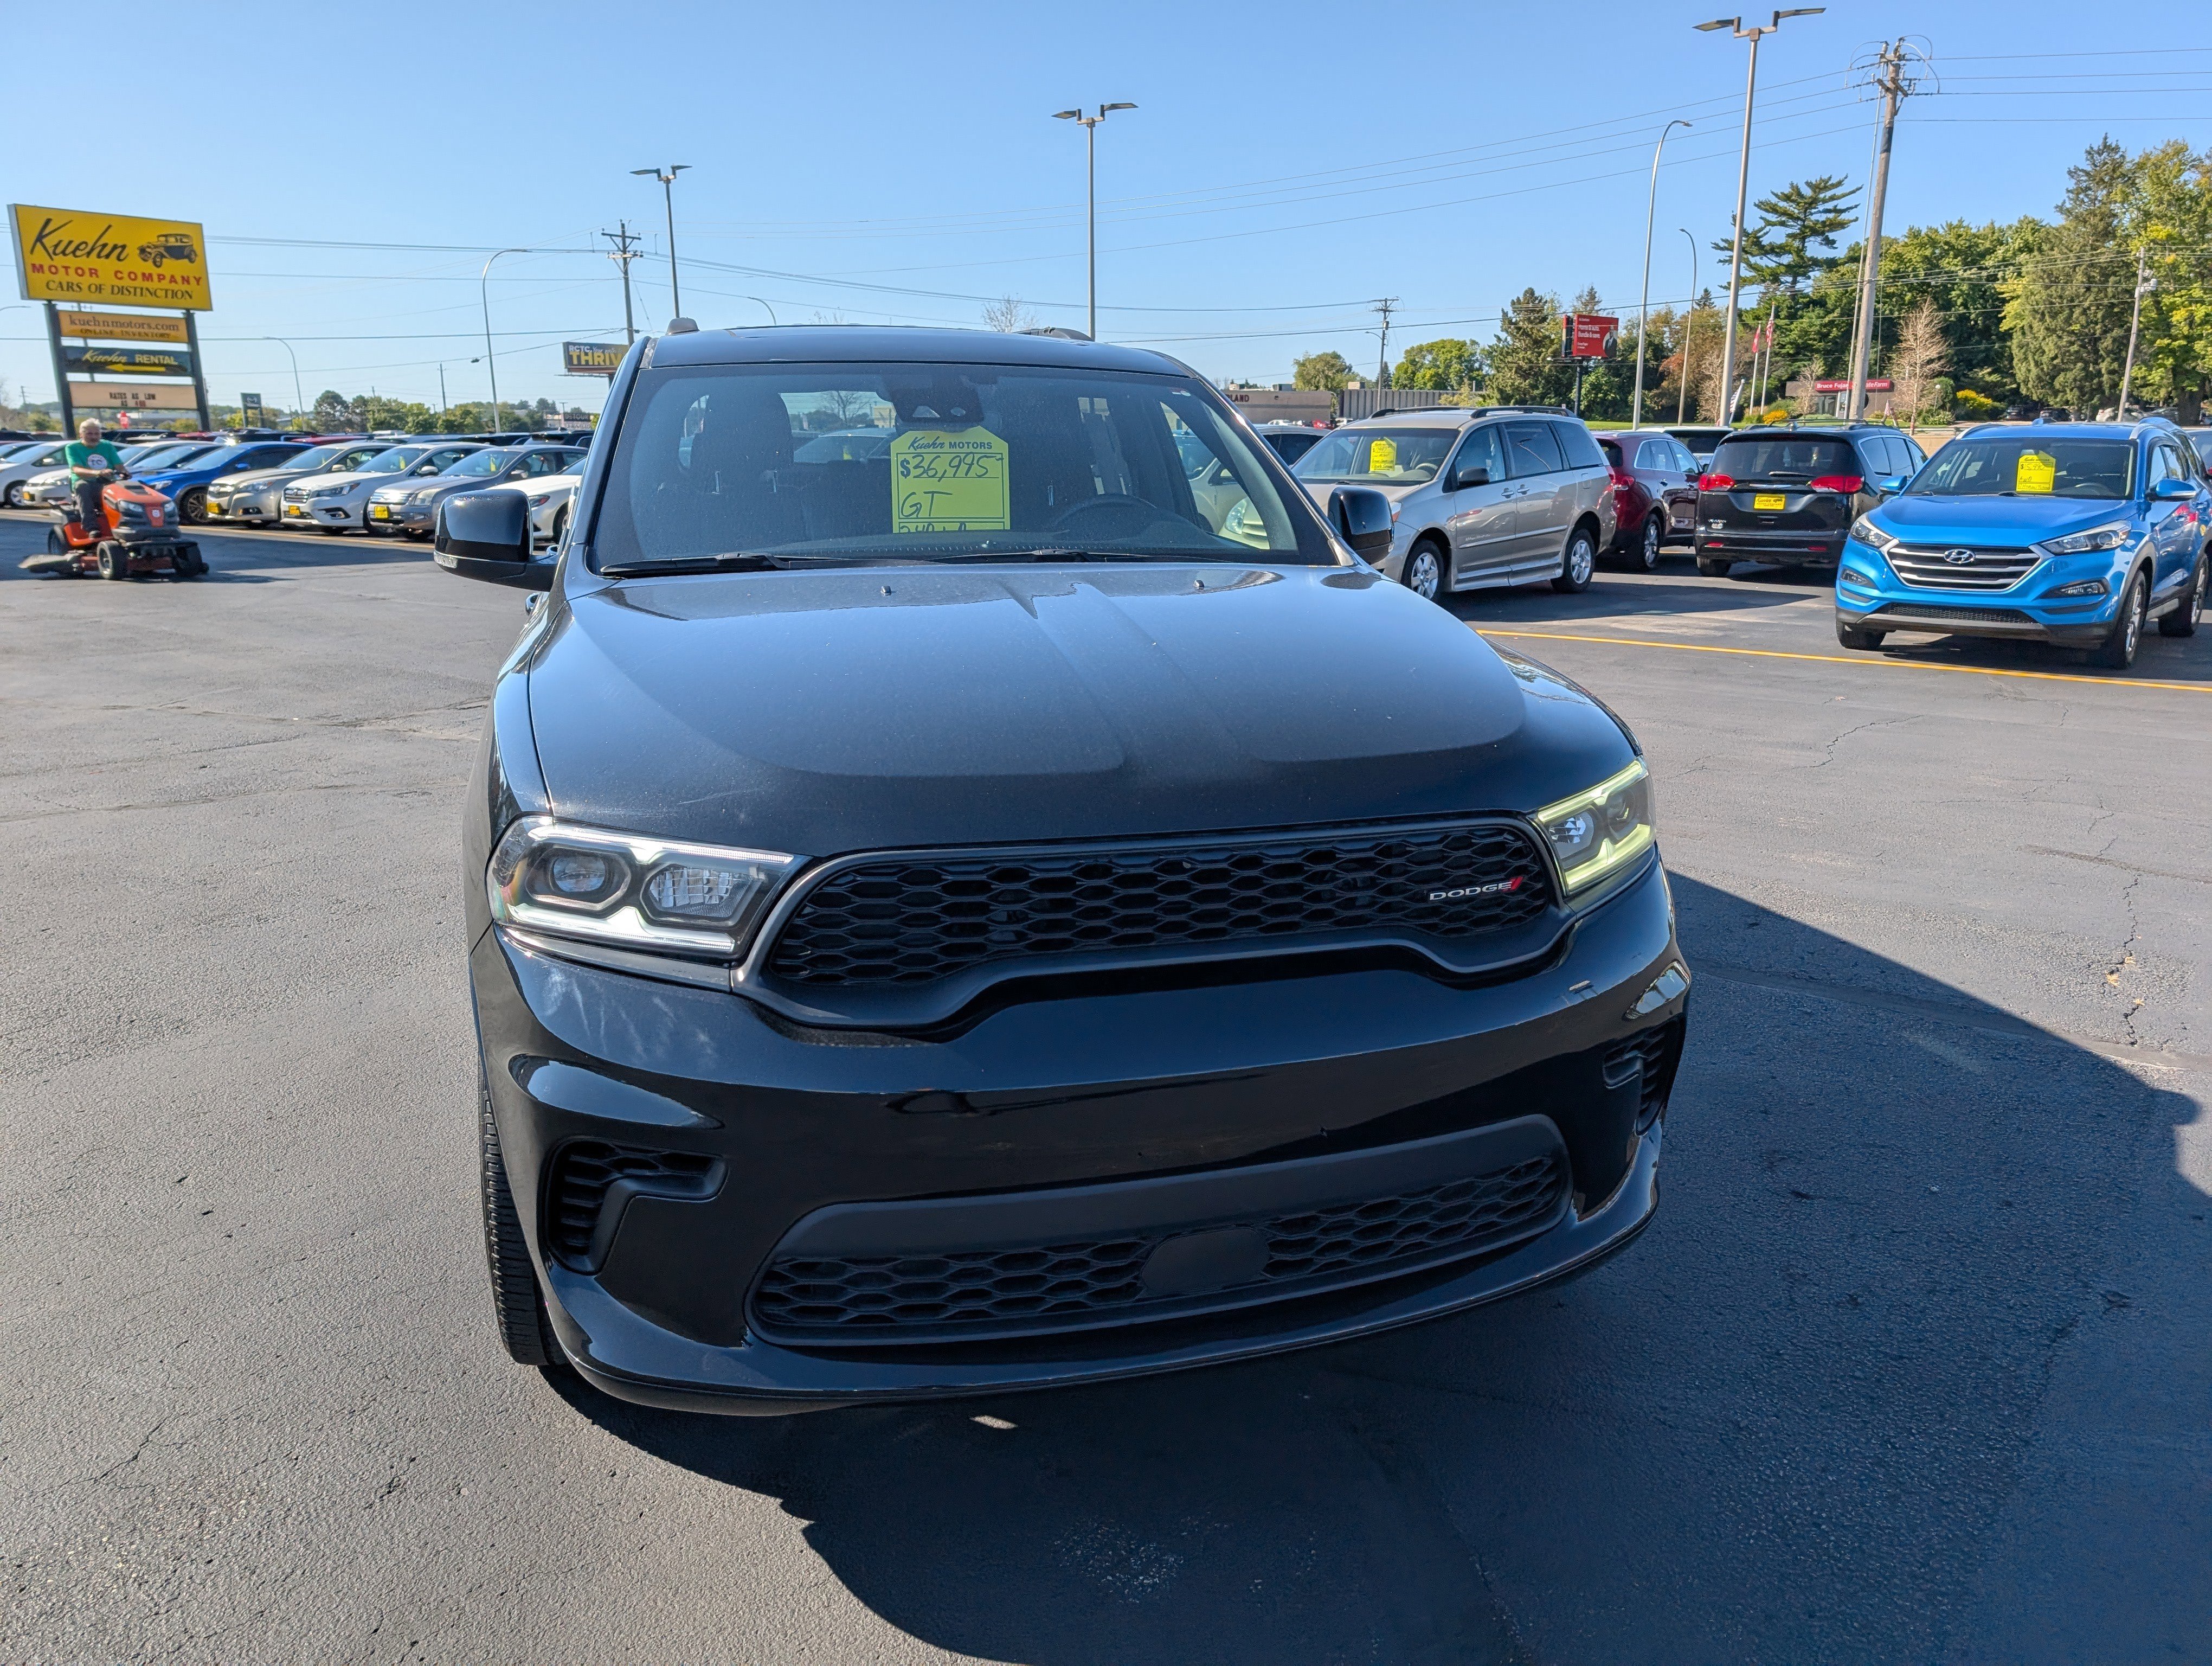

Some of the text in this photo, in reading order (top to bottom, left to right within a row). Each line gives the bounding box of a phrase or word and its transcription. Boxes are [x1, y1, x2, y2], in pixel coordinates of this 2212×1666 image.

[30, 217, 129, 262] Kuehn
[30, 263, 202, 286] MOTOR COMPANY
[46, 280, 193, 299] CARS OF DISTINCTION
[69, 315, 179, 331] kuehnmotors.com
[121, 329, 171, 338] INVENTORY
[82, 349, 178, 365] Kuehn RENTAL
[569, 351, 623, 366] THRIV
[908, 435, 993, 451] Kuehn MOTORS
[901, 490, 953, 518] GT
[1429, 881, 1513, 900] DODGE
